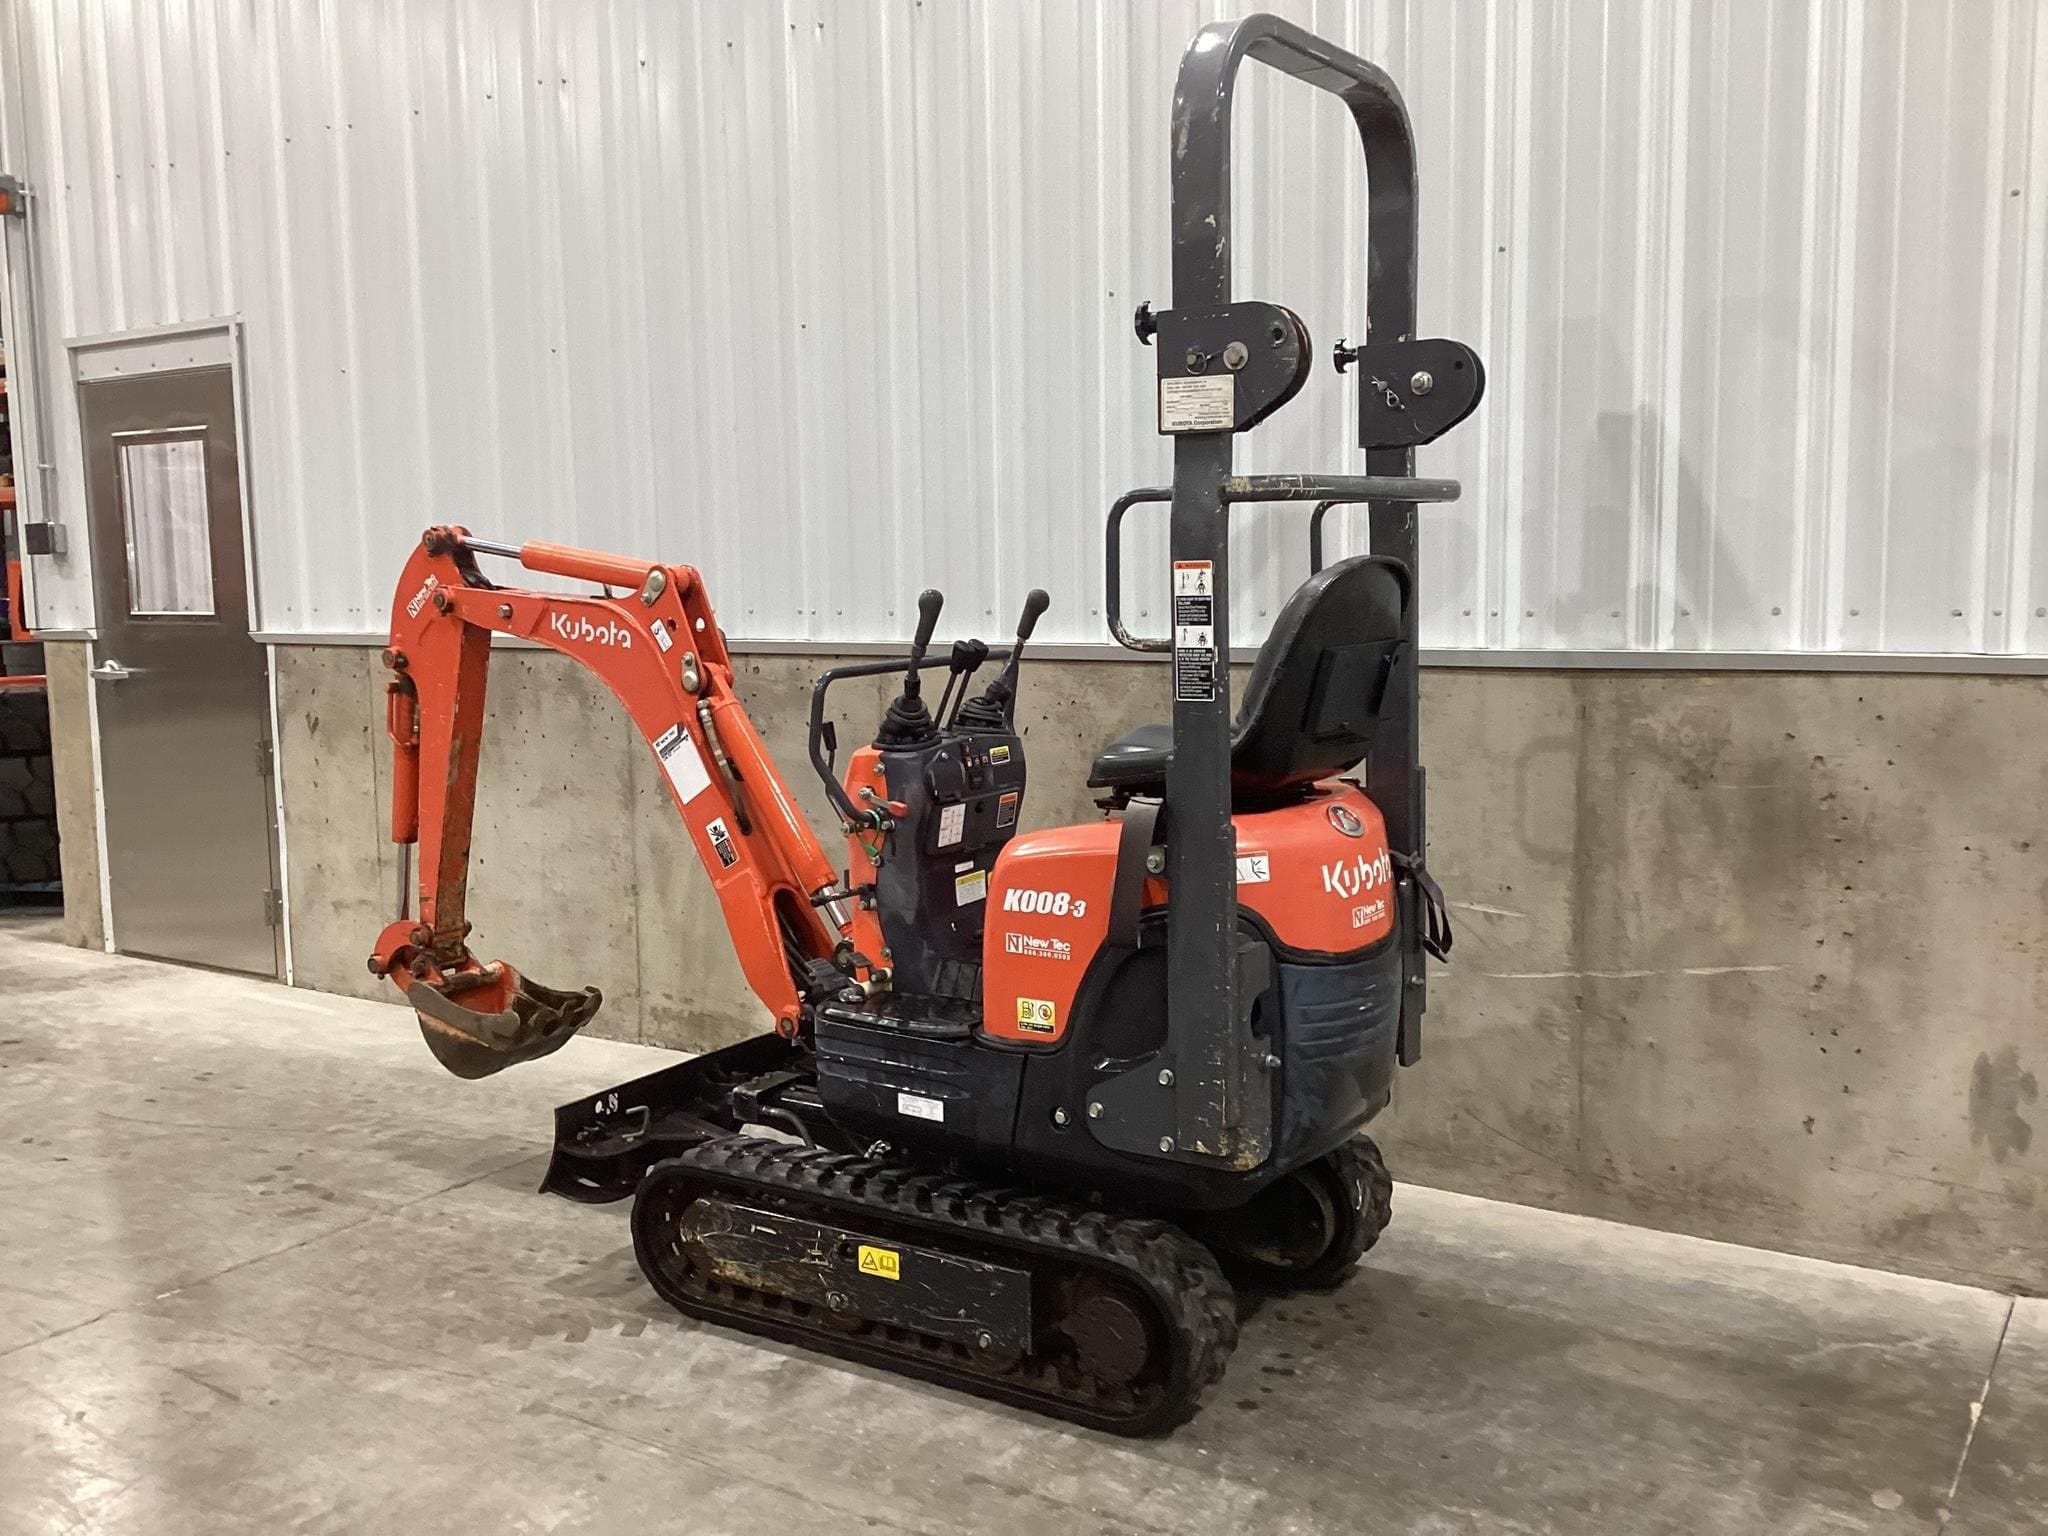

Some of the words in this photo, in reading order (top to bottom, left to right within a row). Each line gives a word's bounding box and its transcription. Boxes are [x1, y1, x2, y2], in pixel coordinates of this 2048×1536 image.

[551, 611, 632, 649] Kubota
[1321, 847, 1392, 899] Kubota
[1003, 888, 1087, 918] K008-3
[1023, 934, 1050, 949] New
[1050, 938, 1071, 952] Tec
